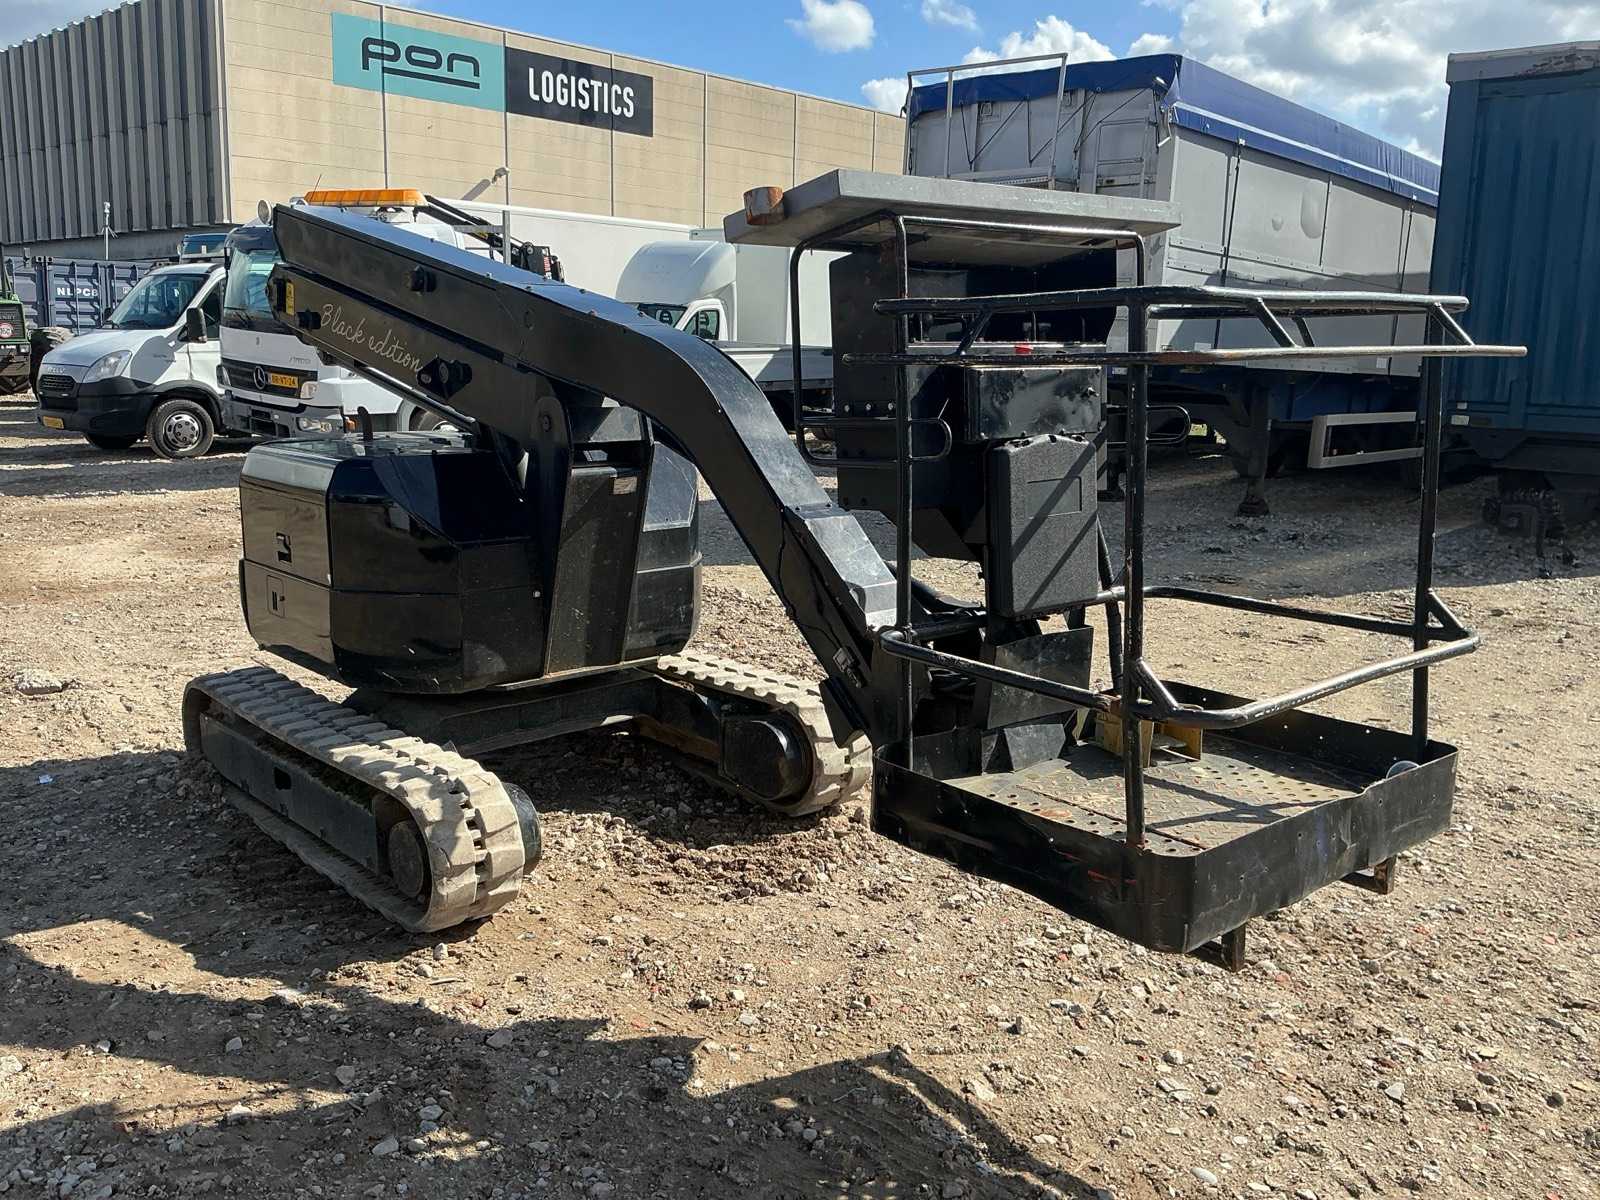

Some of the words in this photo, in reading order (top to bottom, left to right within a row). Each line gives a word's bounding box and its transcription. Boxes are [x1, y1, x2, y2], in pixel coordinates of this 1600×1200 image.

[528, 67, 634, 118] LOGISTICS
[320, 303, 366, 344] Black
[368, 329, 423, 372] edition
